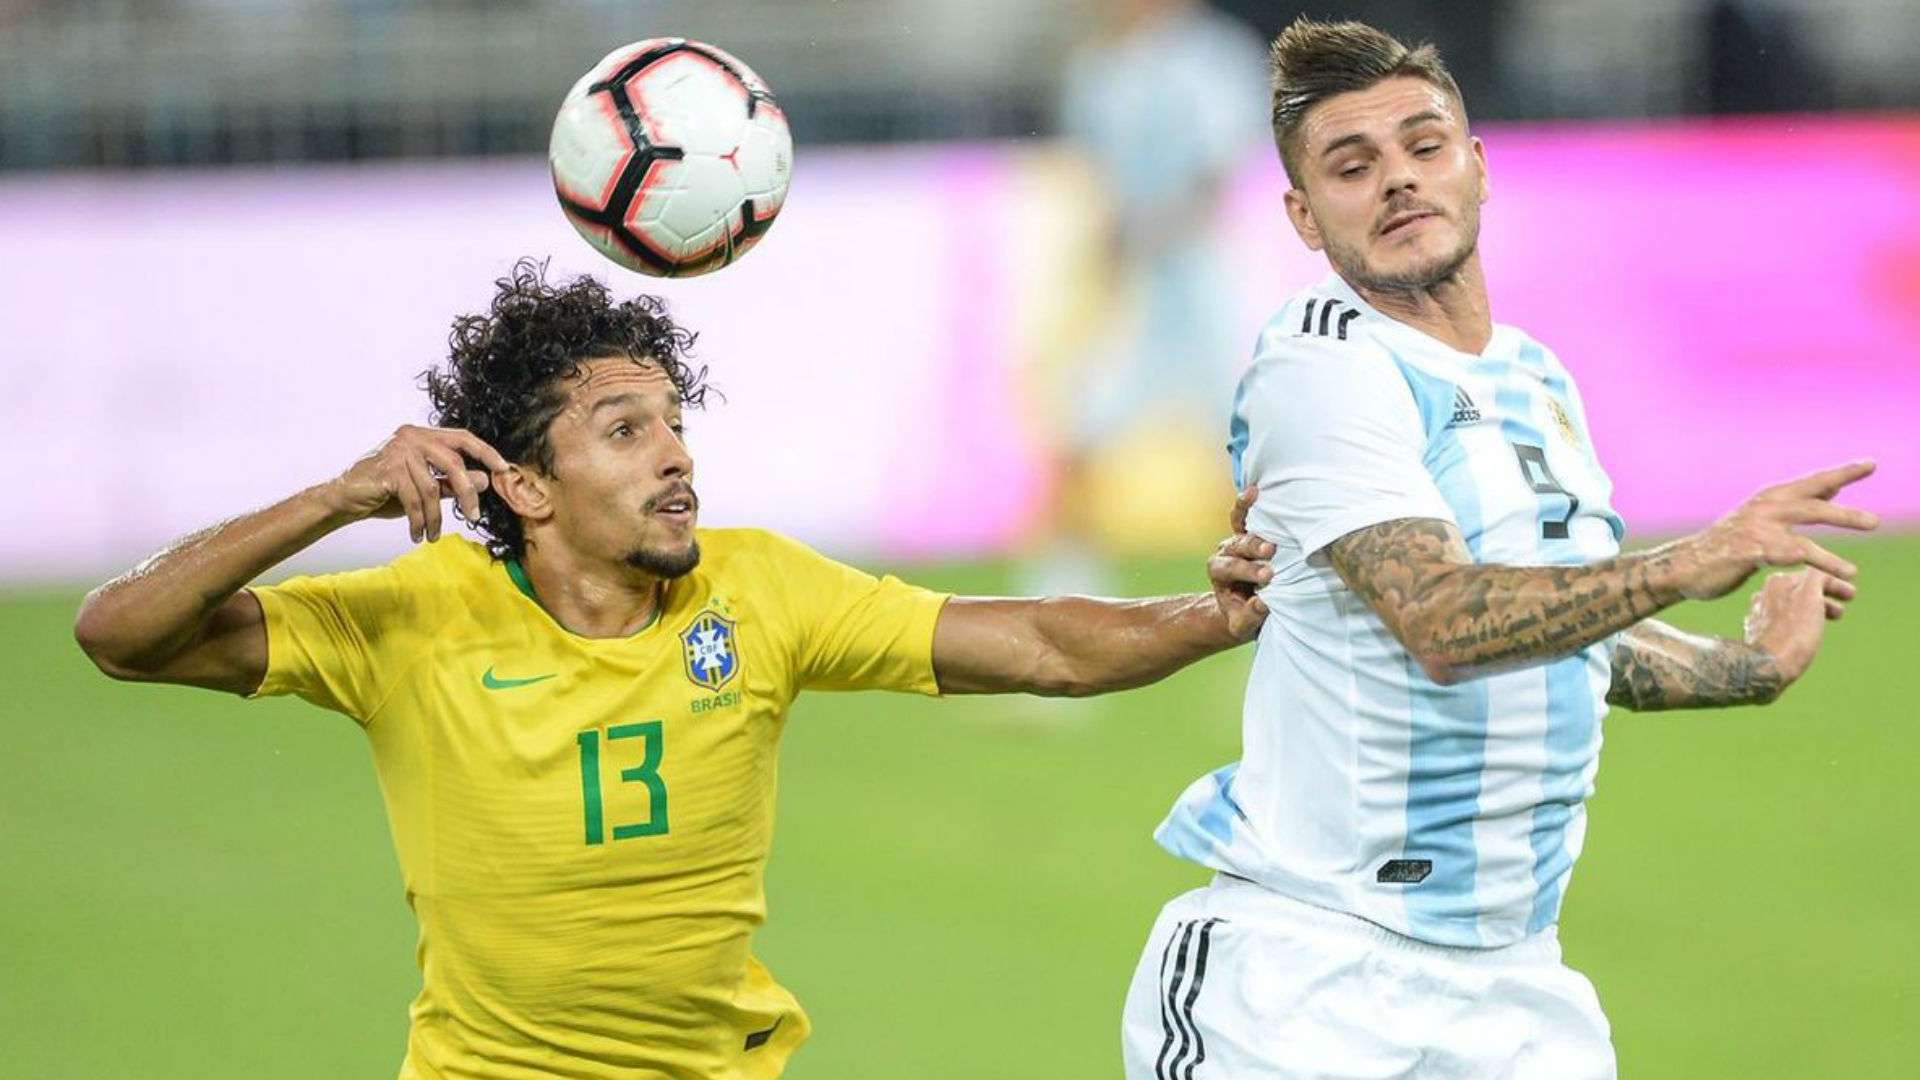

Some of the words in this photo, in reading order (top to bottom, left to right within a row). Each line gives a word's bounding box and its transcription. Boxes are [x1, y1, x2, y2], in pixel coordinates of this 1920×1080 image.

[1514, 444, 1578, 538] 9
[700, 643, 718, 655] CBF
[577, 720, 667, 844] 13
